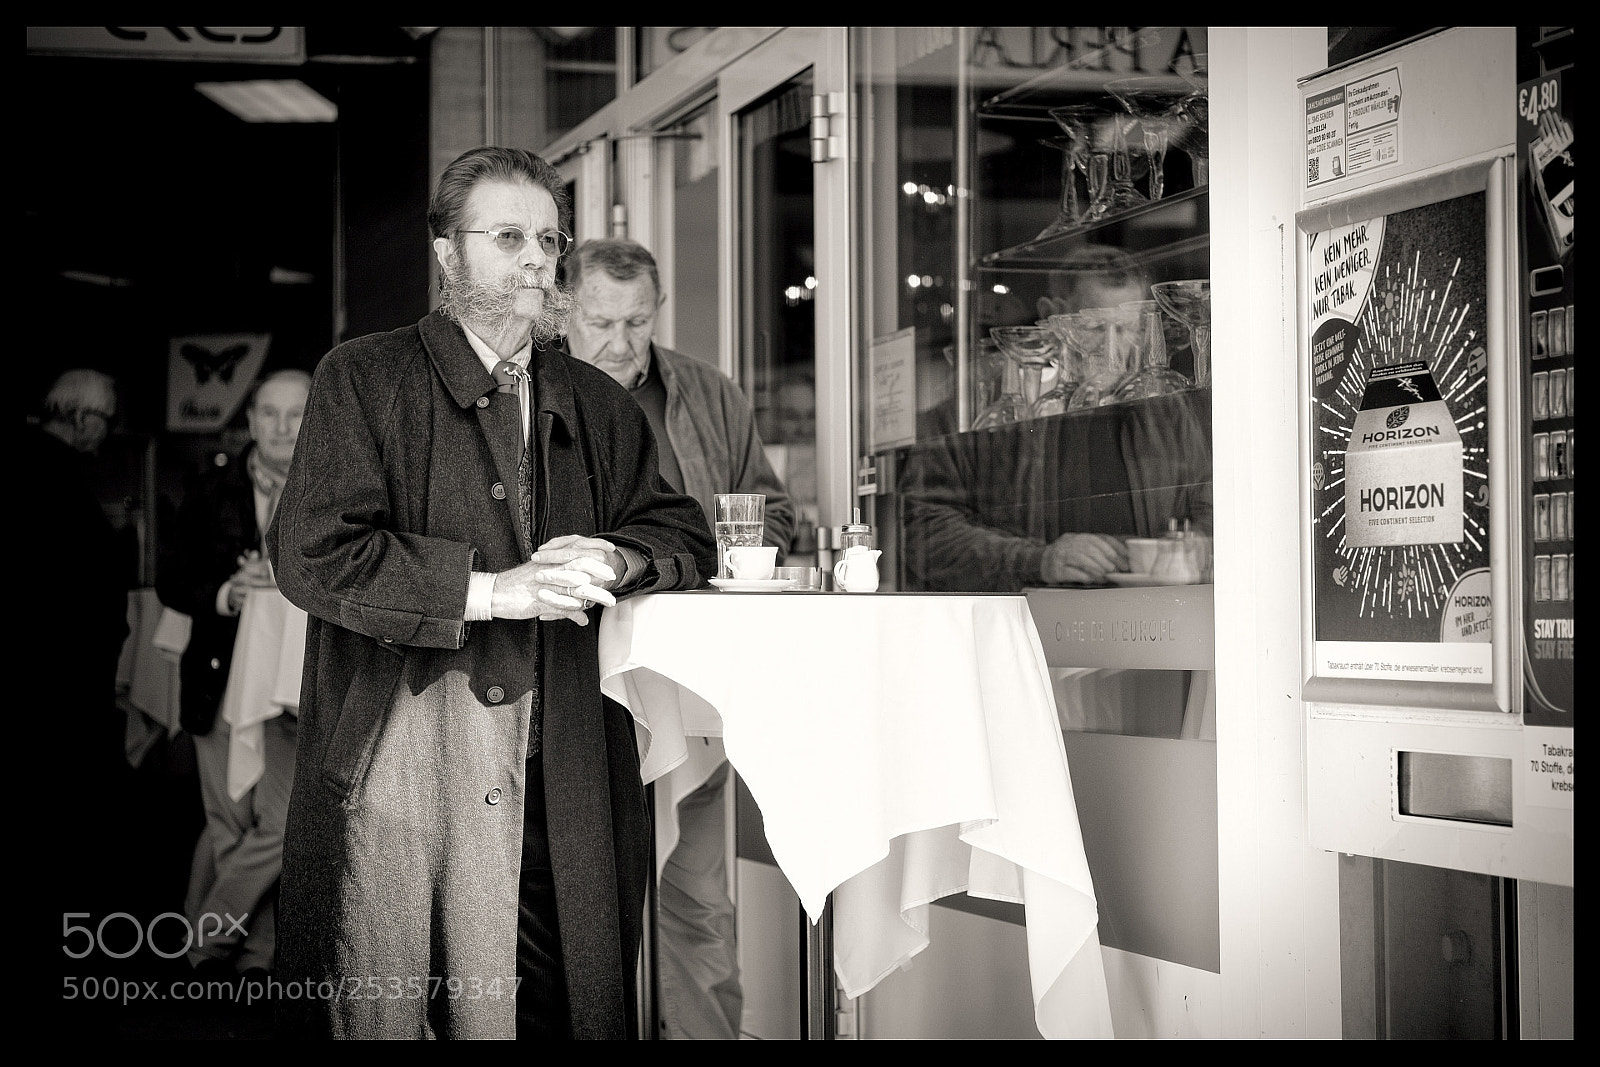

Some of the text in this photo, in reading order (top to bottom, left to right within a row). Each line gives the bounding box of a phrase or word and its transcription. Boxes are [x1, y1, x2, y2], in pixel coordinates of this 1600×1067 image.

[1519, 79, 1558, 125] €4.80
[1323, 239, 1341, 266] KEIN
[1315, 268, 1332, 295] KEIN
[1313, 280, 1357, 320] NUR TABAK.
[1362, 426, 1440, 443] HORIZON
[1360, 482, 1444, 512] HORIZON
[1380, 517, 1408, 525] CONTINENT
[1409, 515, 1435, 524] SELECTION
[1454, 595, 1492, 607] HORIZON
[1111, 620, 1176, 642] L'EUROPE
[1534, 618, 1555, 639] STAY
[1535, 640, 1555, 660] STAY
[1327, 660, 1350, 670] Tabakrauch
[1543, 743, 1573, 757] Tabakra
[1531, 760, 1540, 772] 70
[1541, 760, 1565, 776] Stoffe,
